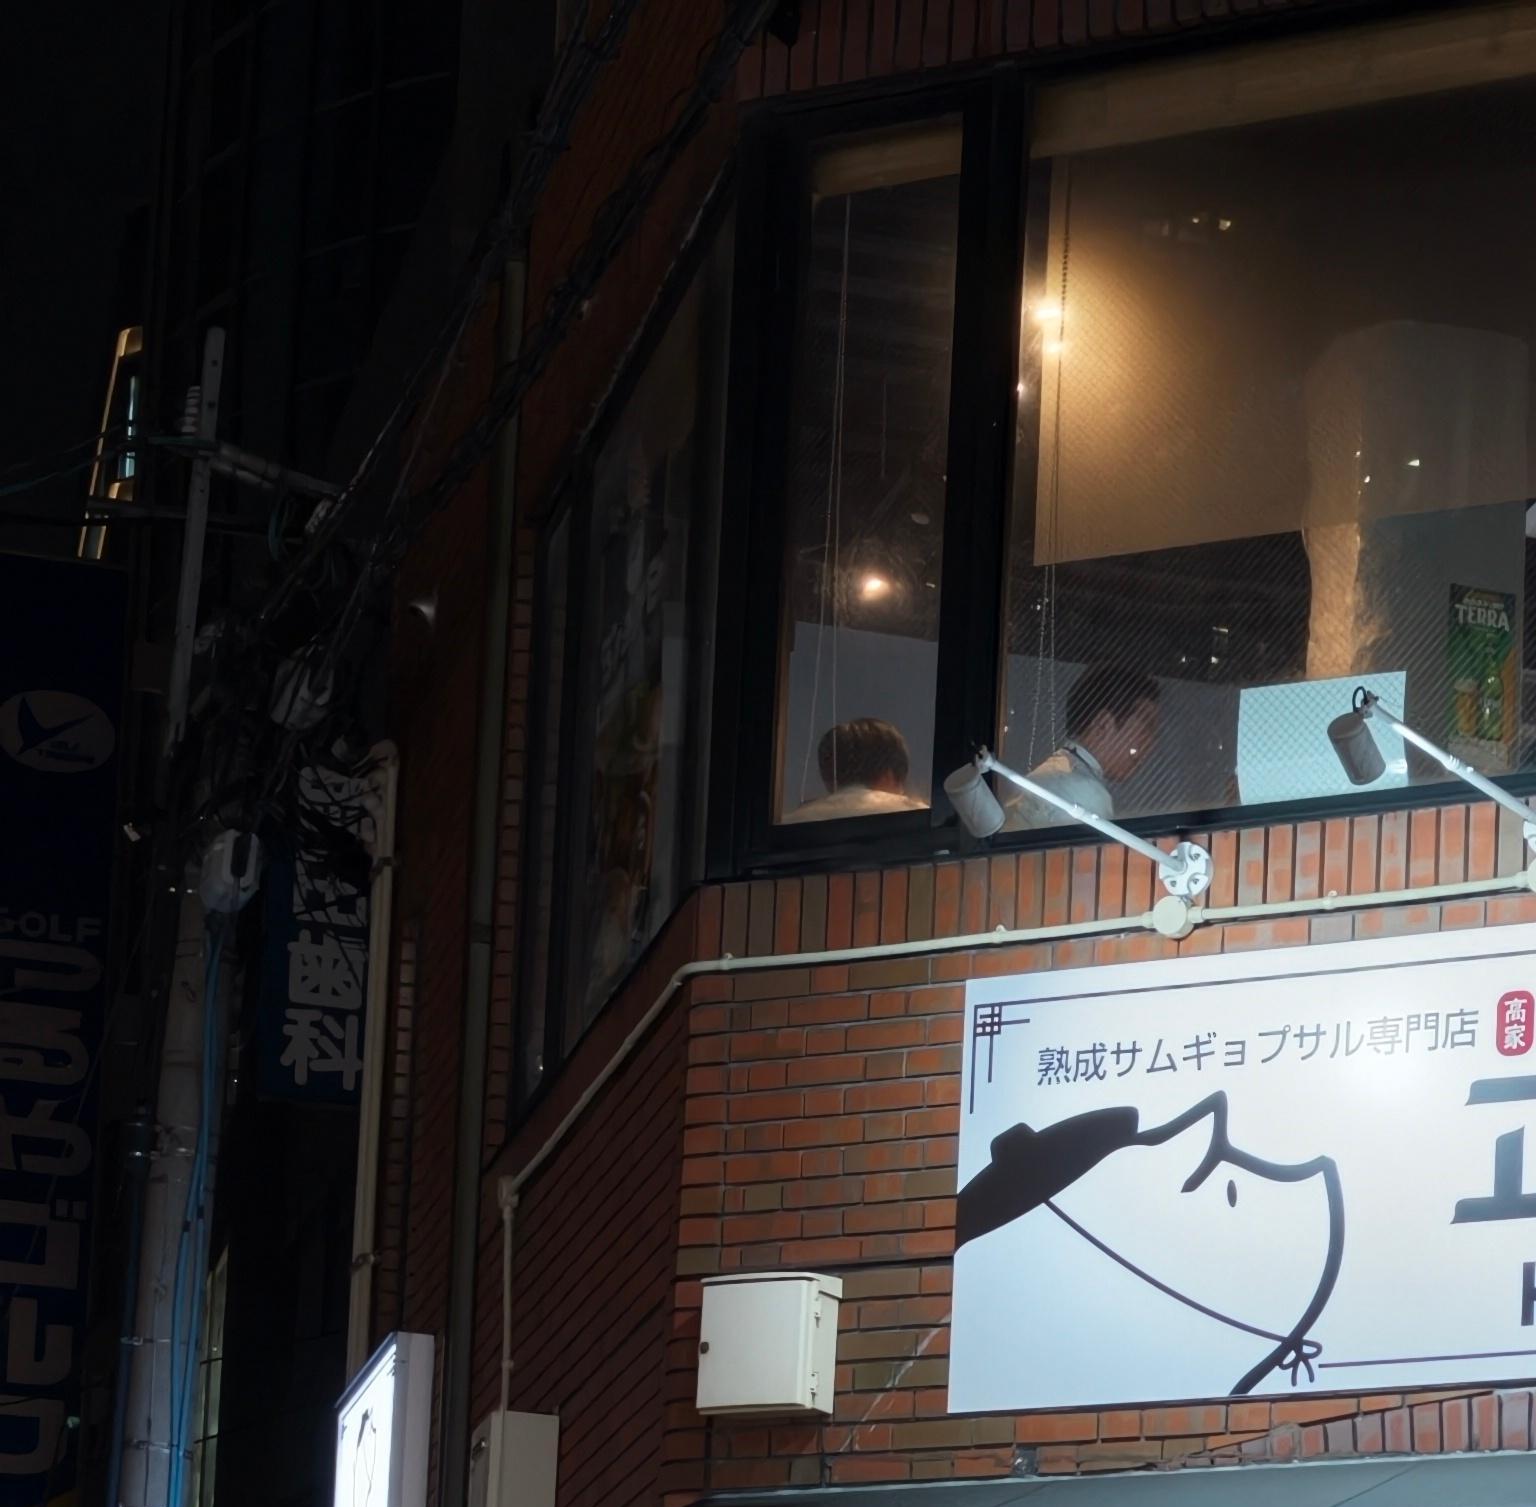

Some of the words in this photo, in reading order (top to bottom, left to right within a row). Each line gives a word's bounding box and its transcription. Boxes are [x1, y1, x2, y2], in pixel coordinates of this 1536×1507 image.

[1454, 603, 1510, 632] TERRA
[1035, 1007, 1480, 1087] 熟成サムギョプサル専門店
